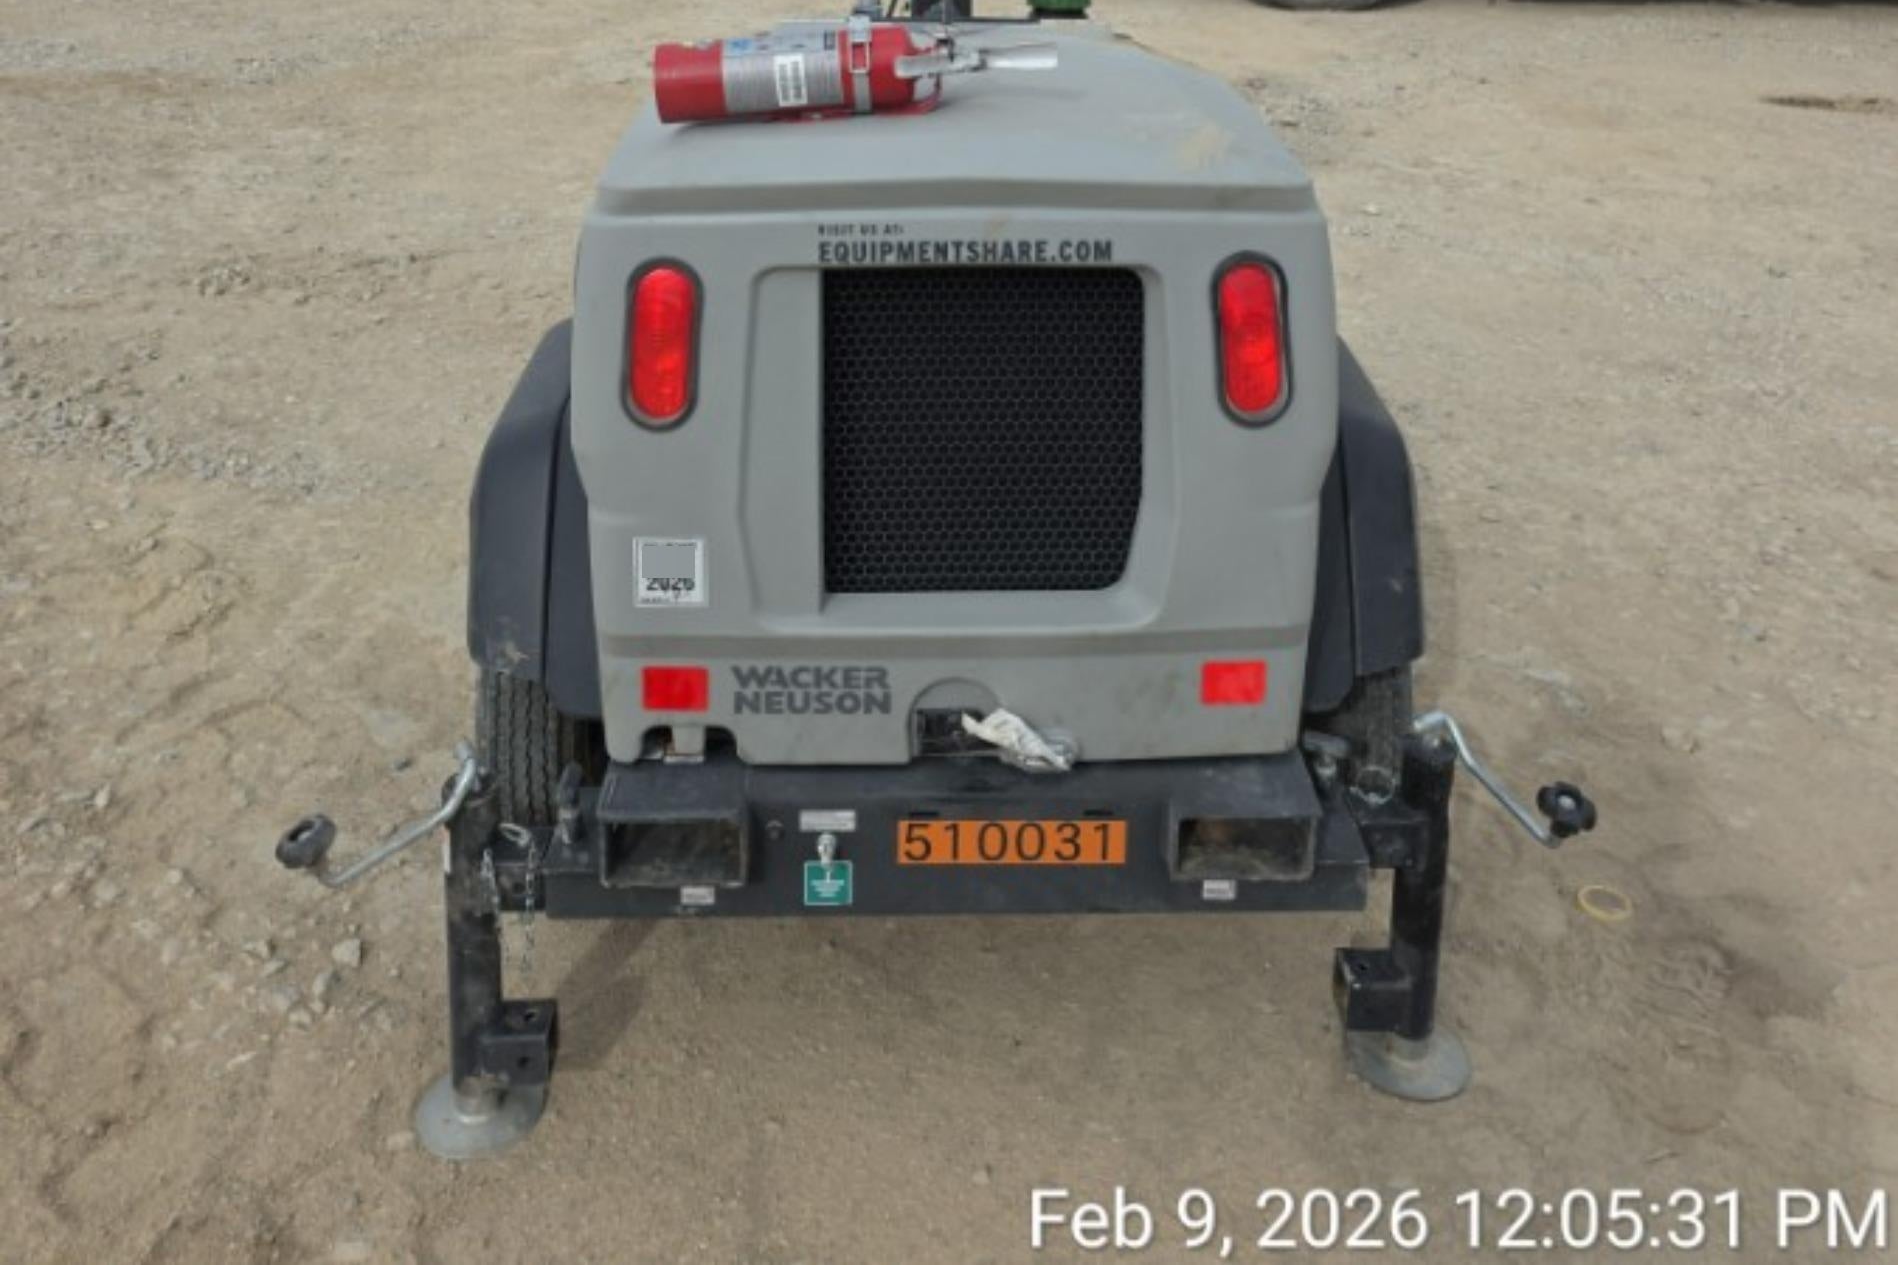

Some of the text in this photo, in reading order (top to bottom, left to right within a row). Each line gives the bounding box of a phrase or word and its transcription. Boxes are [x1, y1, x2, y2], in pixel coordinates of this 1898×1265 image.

[818, 240, 1113, 264] EQUIPMENTSHARE.COM
[731, 665, 891, 690] WACKER
[733, 690, 892, 715] NEUSON
[904, 822, 1111, 862] 510031
